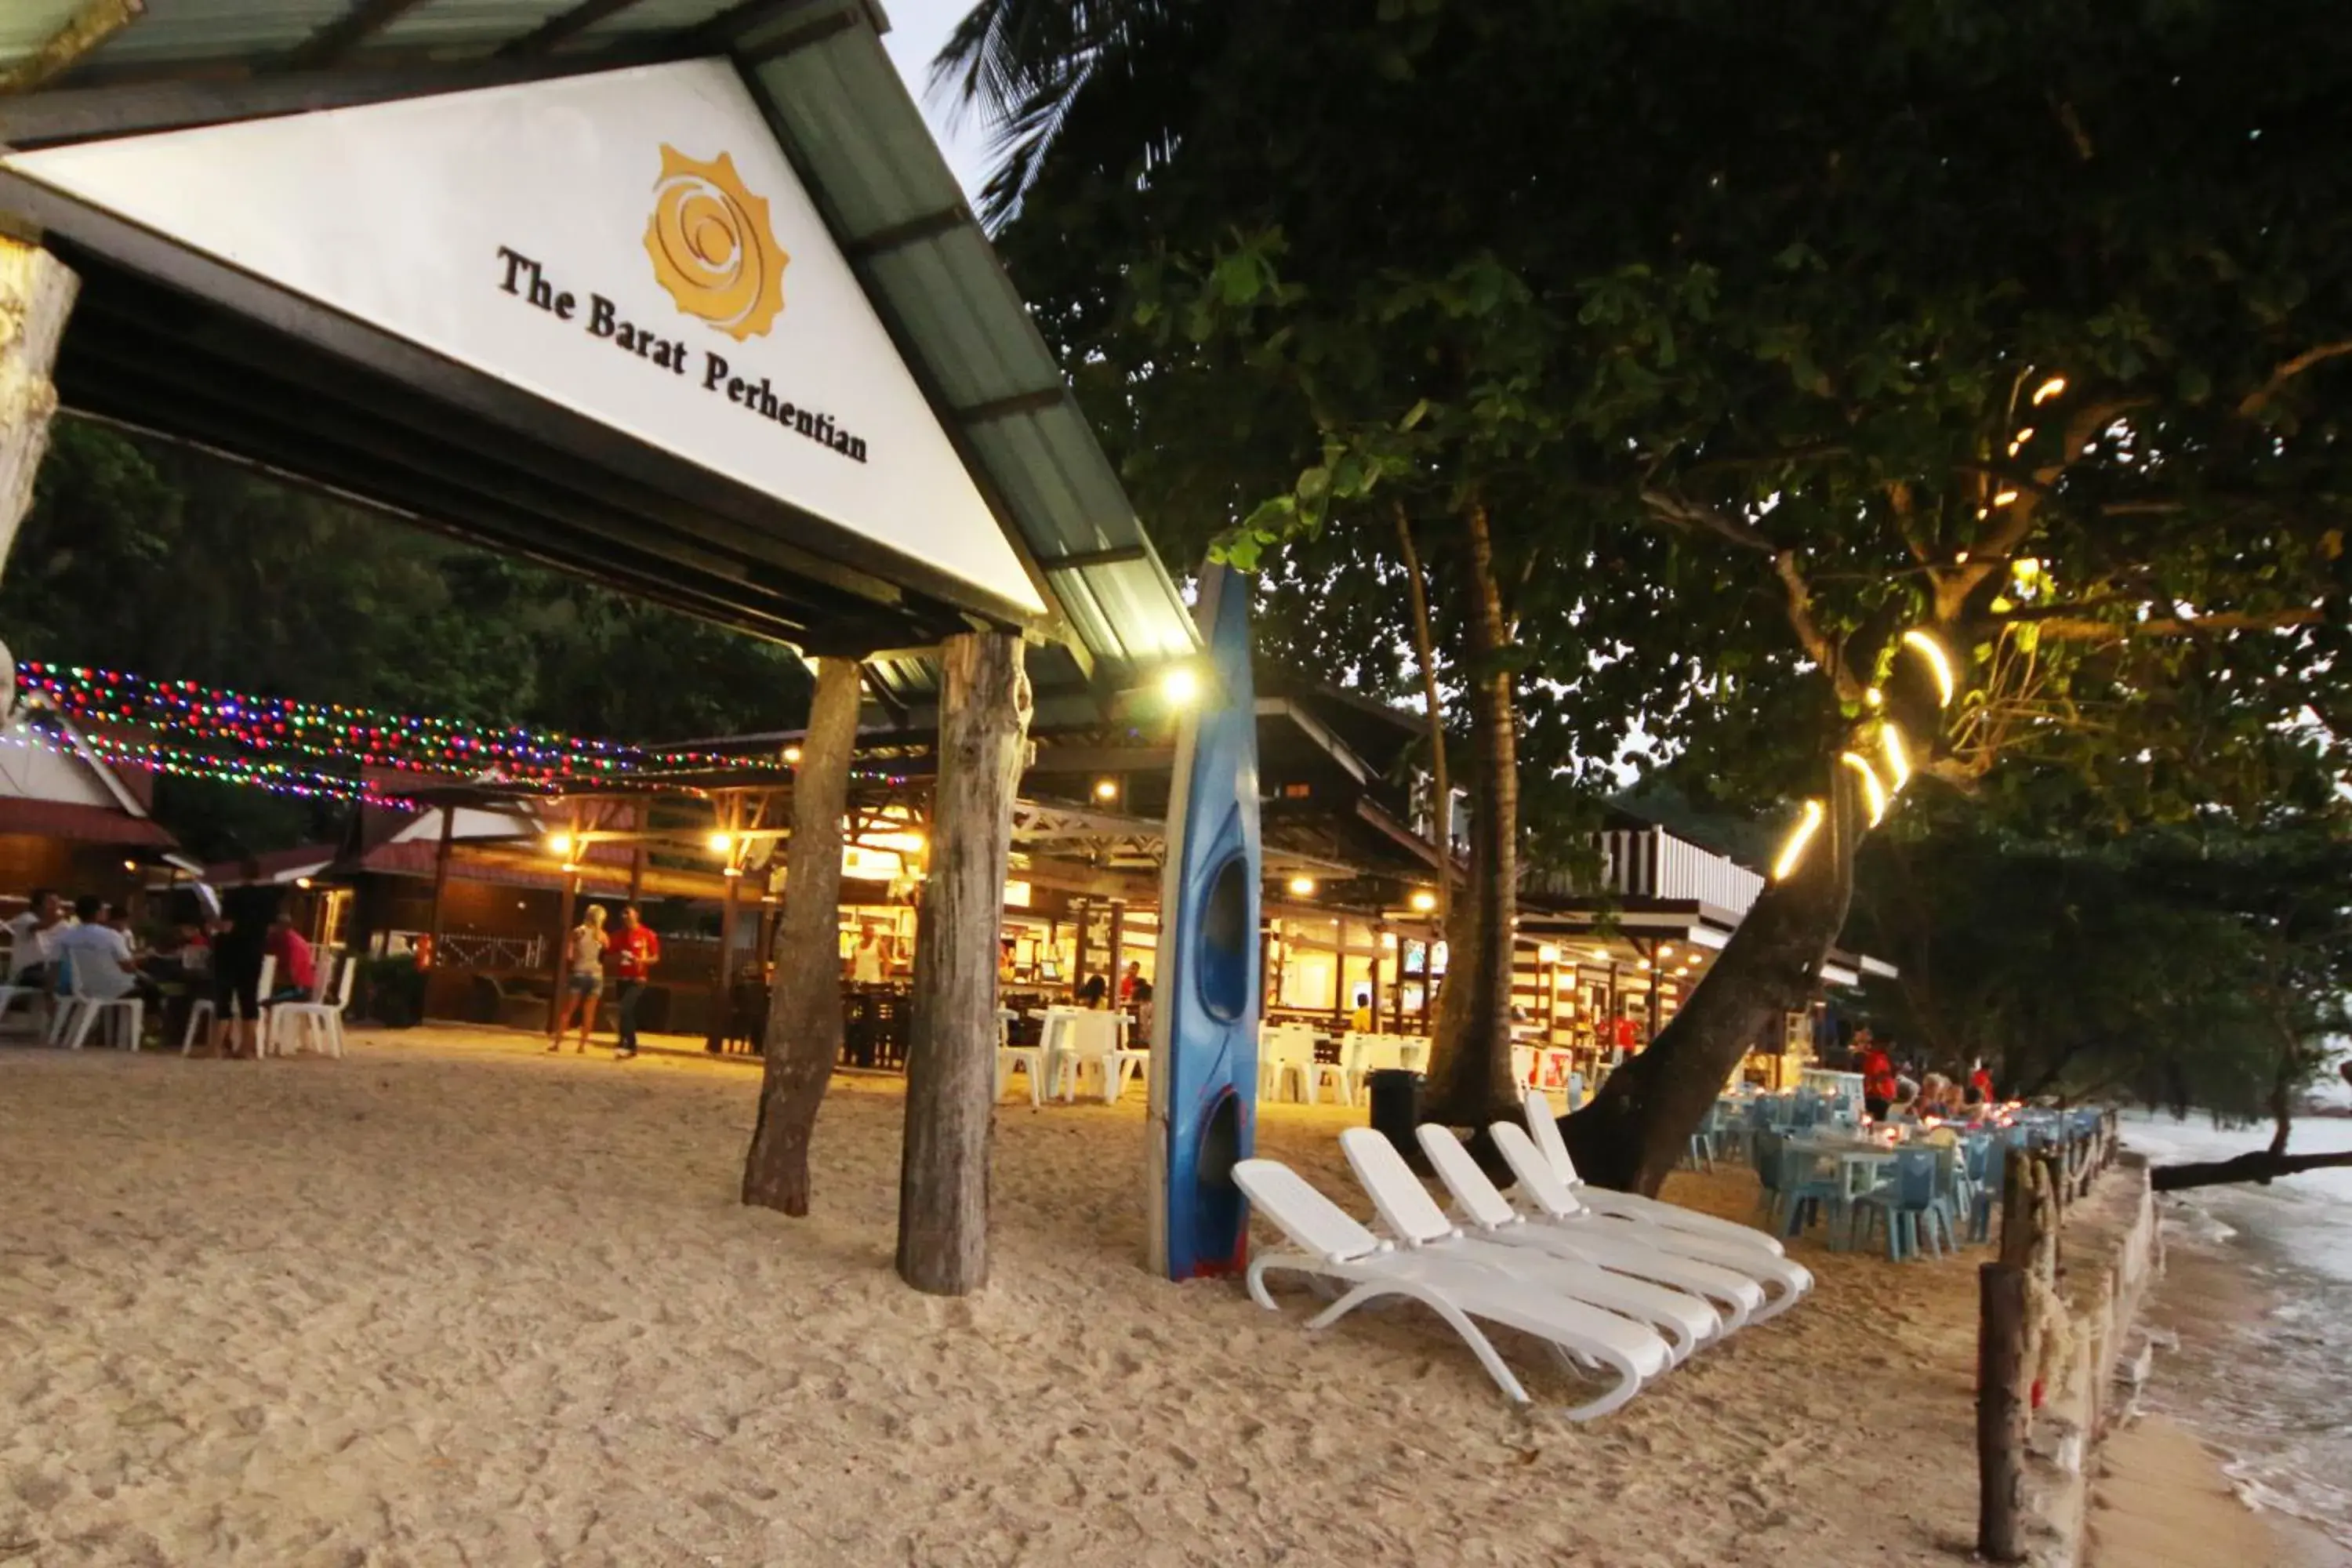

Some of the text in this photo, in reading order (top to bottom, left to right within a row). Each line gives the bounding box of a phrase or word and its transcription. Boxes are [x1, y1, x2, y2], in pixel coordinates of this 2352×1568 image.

[498, 245, 868, 464] The Barat Perhentian
